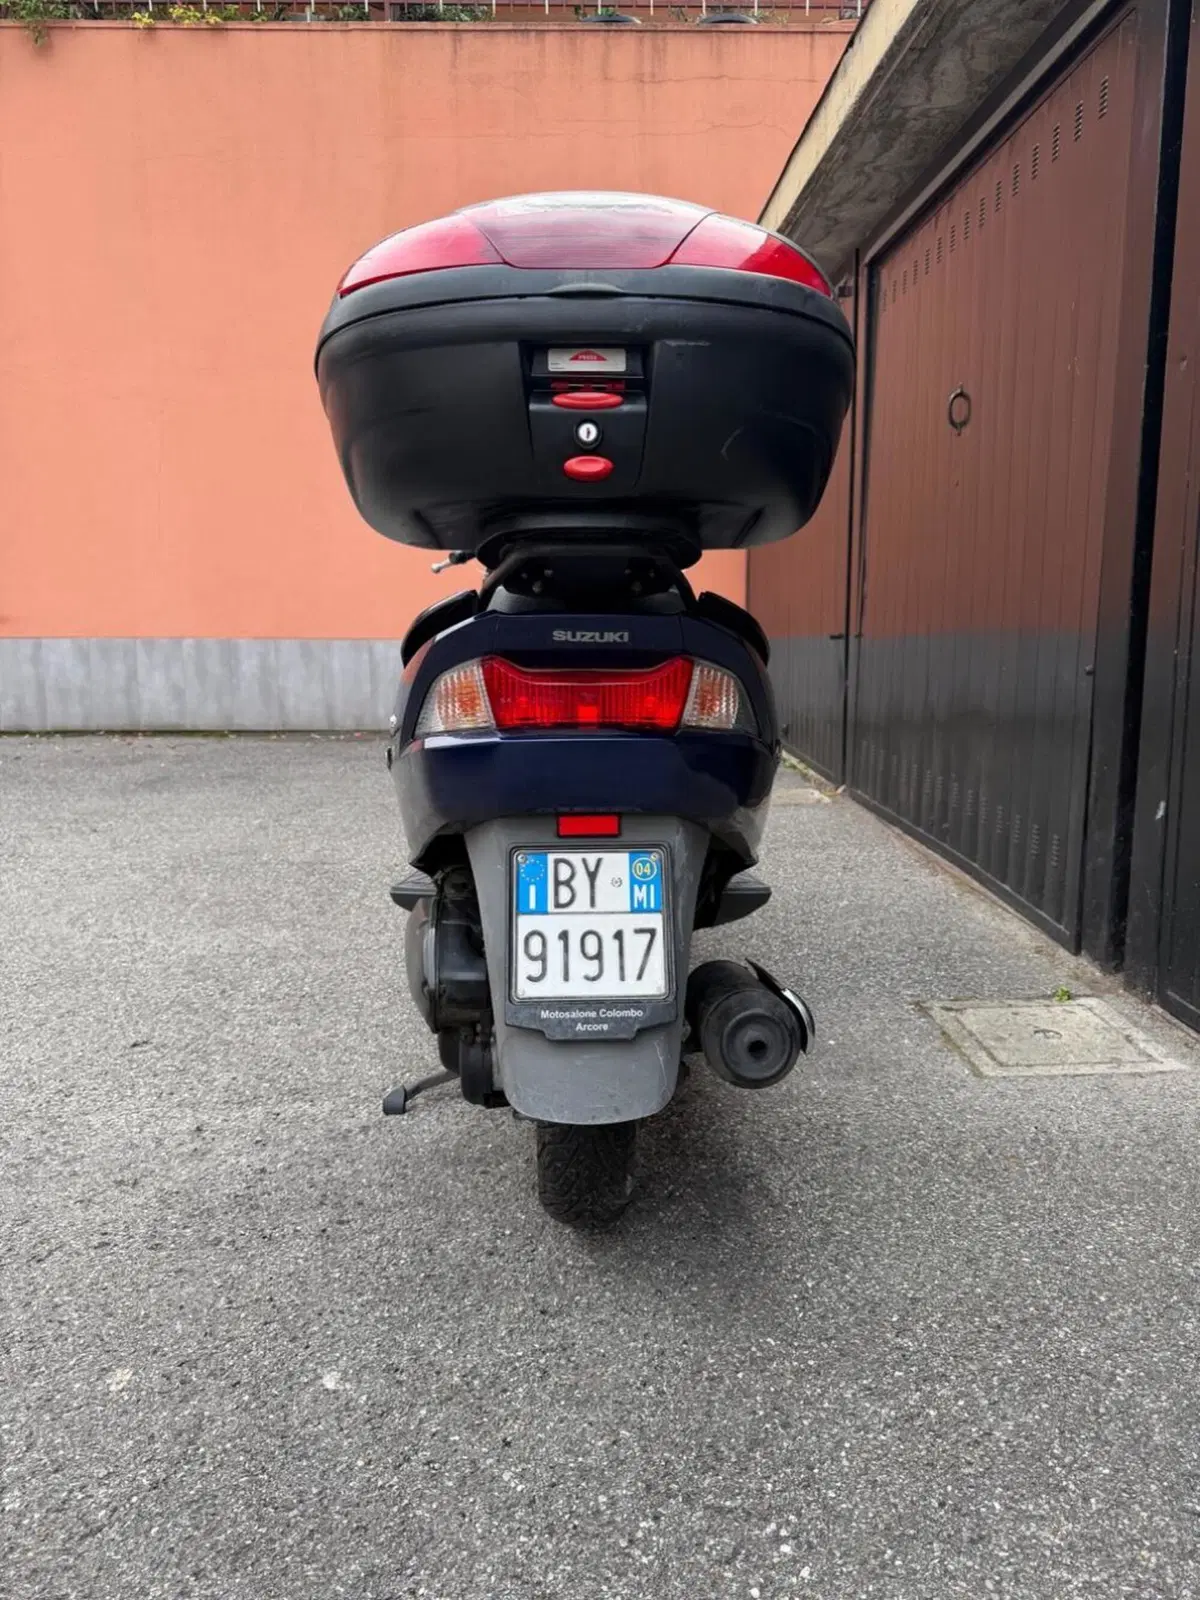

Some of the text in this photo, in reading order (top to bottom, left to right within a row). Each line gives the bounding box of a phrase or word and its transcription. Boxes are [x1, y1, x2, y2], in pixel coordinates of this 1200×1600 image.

[552, 630, 629, 642] SUZUKI
[635, 862, 651, 876] 04
[553, 857, 603, 909] BY
[633, 884, 655, 909] MI
[523, 928, 657, 983] 91917
[540, 1008, 643, 1019] Motosalone Colombo
[575, 1022, 609, 1031] Arcore
